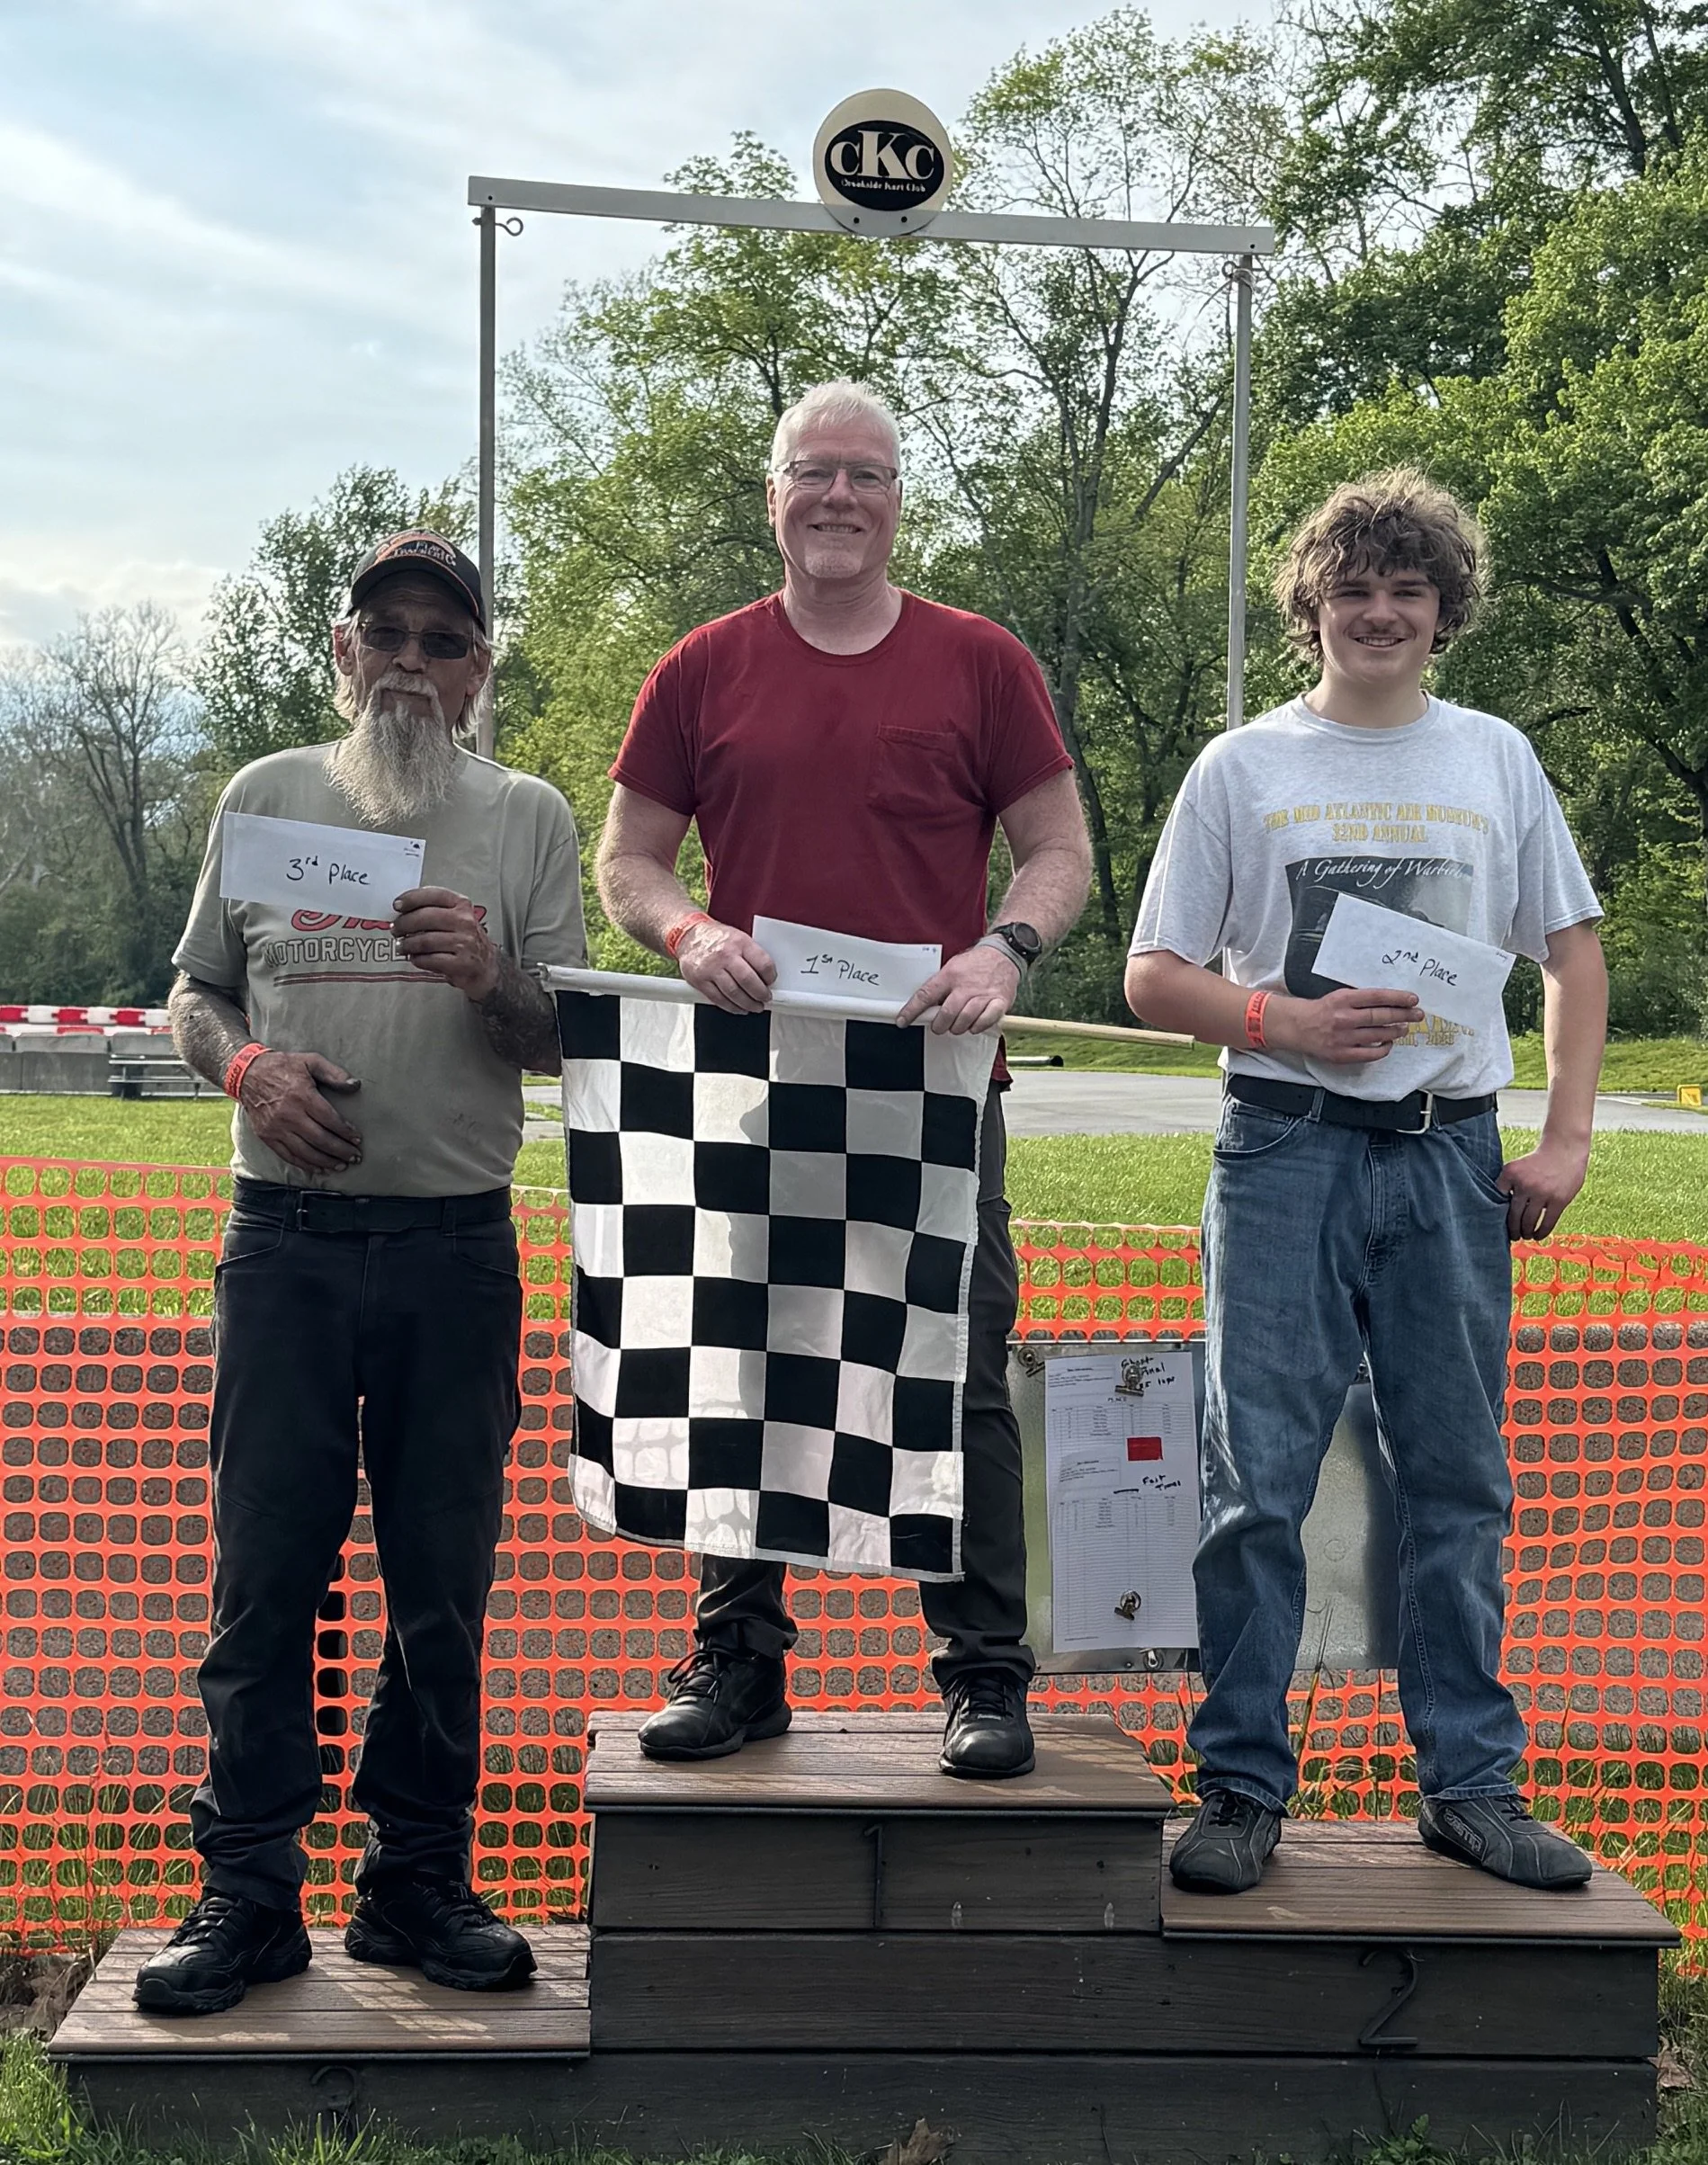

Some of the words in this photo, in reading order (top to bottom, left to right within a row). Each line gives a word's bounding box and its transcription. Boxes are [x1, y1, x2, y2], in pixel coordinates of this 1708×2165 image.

[830, 130, 934, 180] CKC
[884, 182, 905, 191] Kart
[906, 183, 926, 192] Club
[1293, 804, 1320, 823] MID
[1325, 801, 1392, 821] ATLANTIC
[1396, 802, 1422, 820] AIR
[1373, 824, 1428, 843] ANNUAL
[286, 855, 318, 881] 3rd
[1295, 859, 1309, 881] A
[1313, 855, 1383, 888] Gathering
[1373, 856, 1406, 890] of
[263, 936, 411, 968] MOTORCYCL
[1382, 950, 1419, 965] 2nd
[1418, 958, 1457, 986] Place
[800, 953, 833, 974] 1st
[837, 959, 880, 986] Place
[1358, 1946, 1419, 2047] 2
